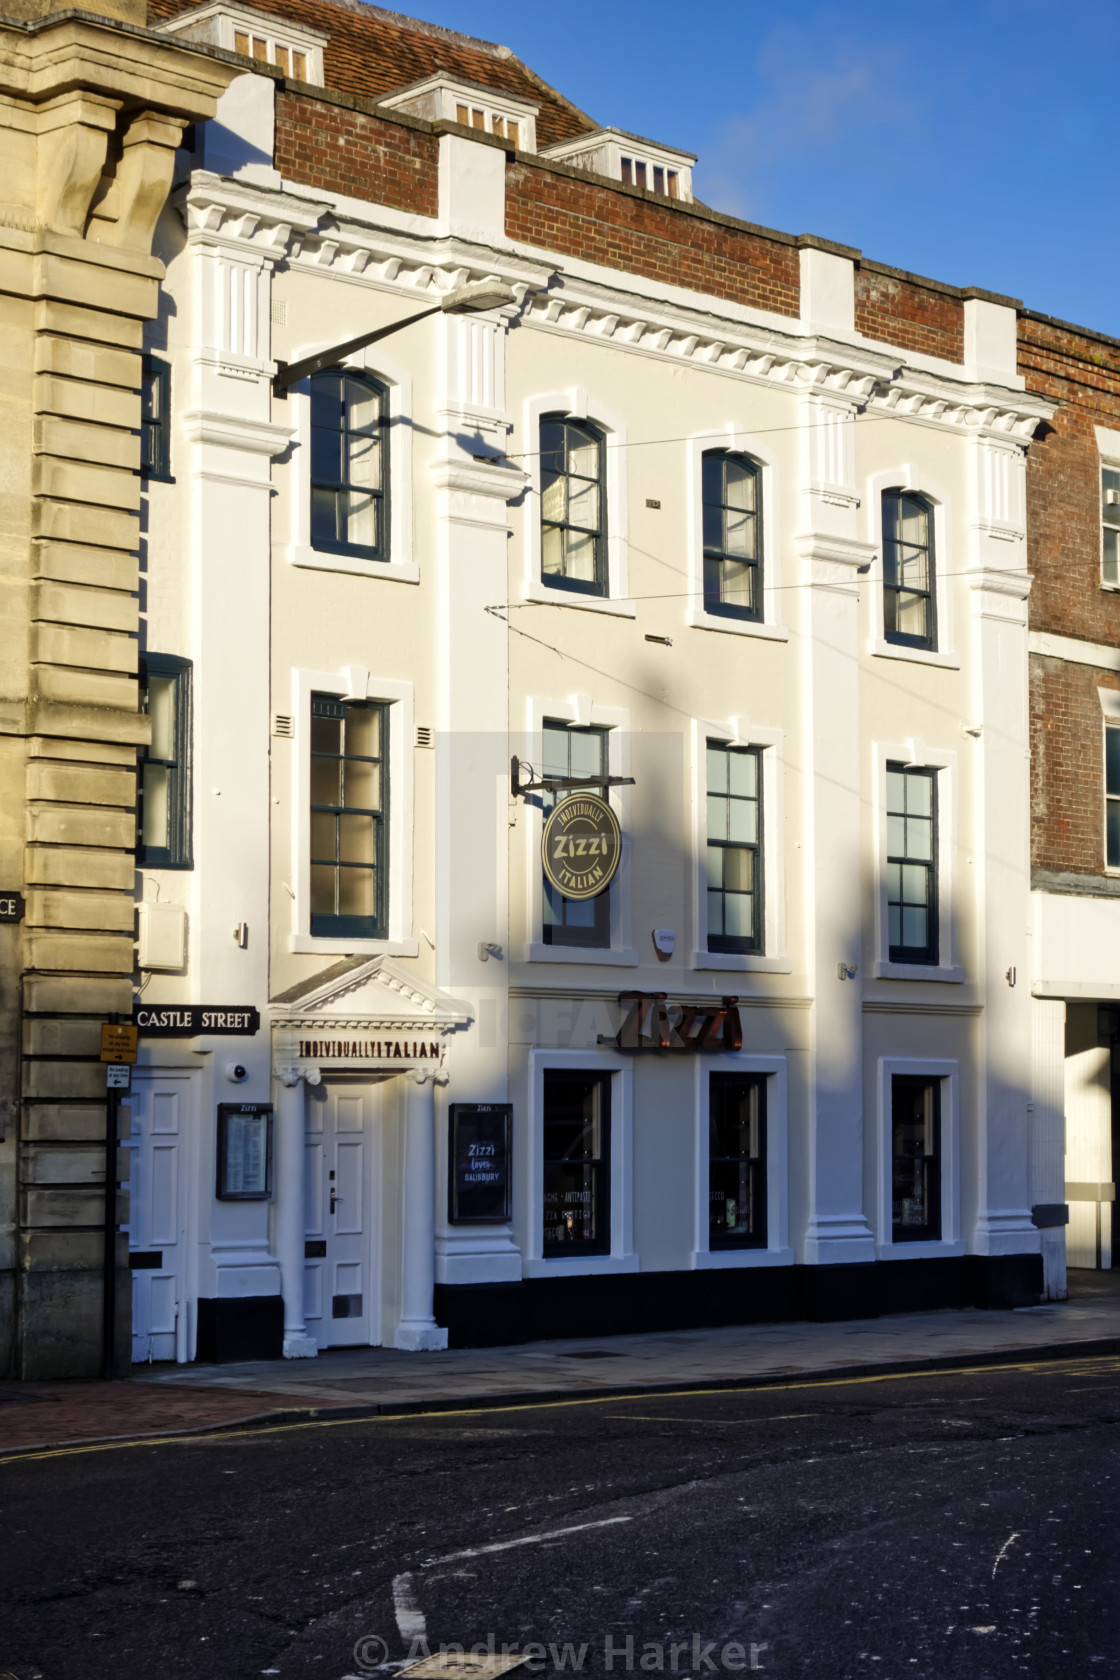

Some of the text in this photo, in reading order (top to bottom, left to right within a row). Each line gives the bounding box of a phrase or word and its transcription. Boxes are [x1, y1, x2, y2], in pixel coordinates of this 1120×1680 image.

[557, 803, 605, 827] INDIVIDUALLY
[553, 832, 608, 859] Zizzi
[558, 865, 604, 889] ITALIAN
[137, 1011, 251, 1028] CASTLE STREET
[468, 1144, 495, 1157] Zizzi
[464, 1172, 500, 1182] SALISBURY
